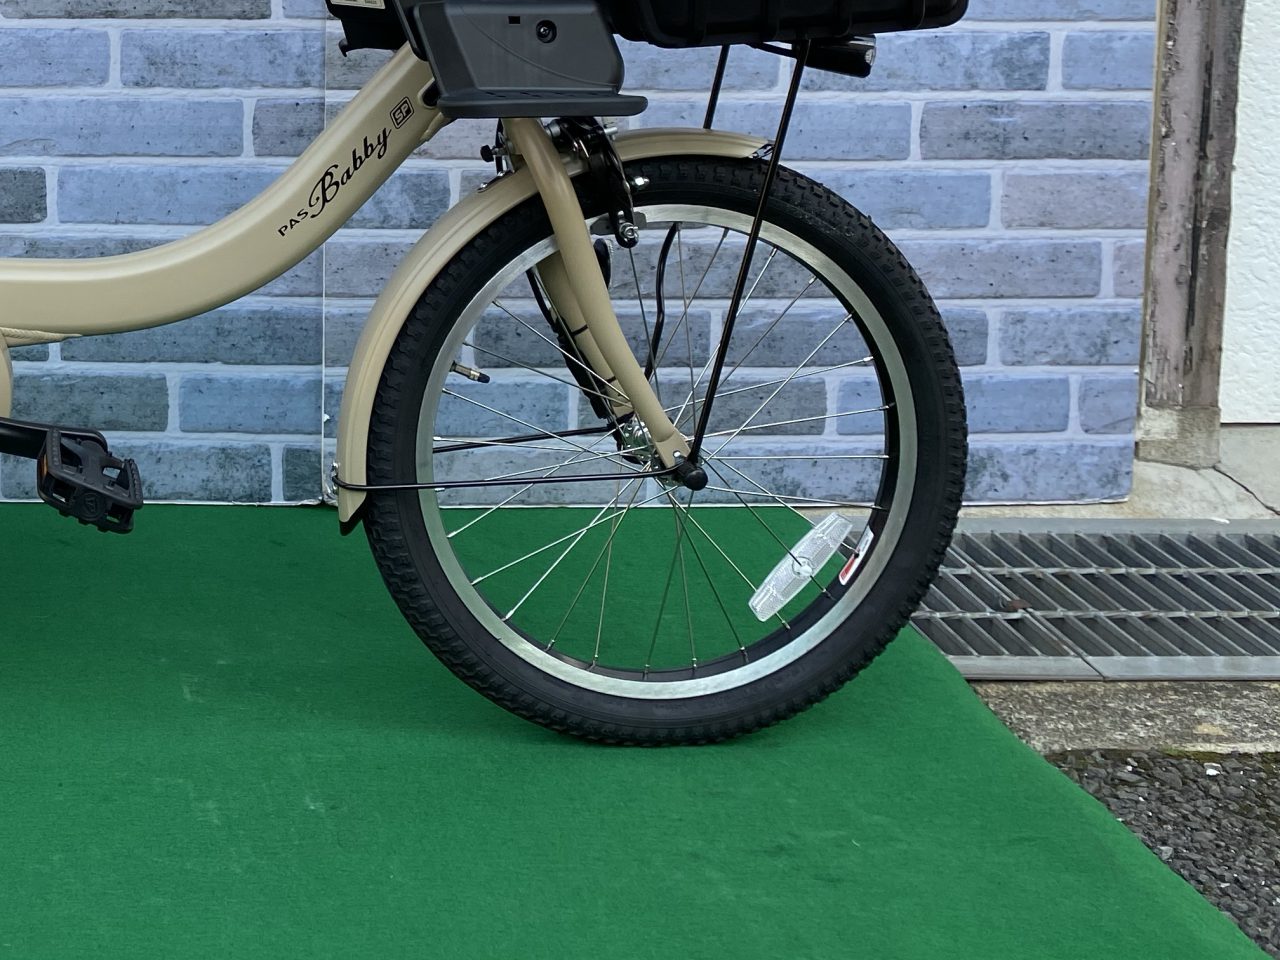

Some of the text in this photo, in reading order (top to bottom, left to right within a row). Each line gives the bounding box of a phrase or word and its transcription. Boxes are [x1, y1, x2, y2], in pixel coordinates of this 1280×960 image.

[277, 99, 412, 237] PAS Babby SP
